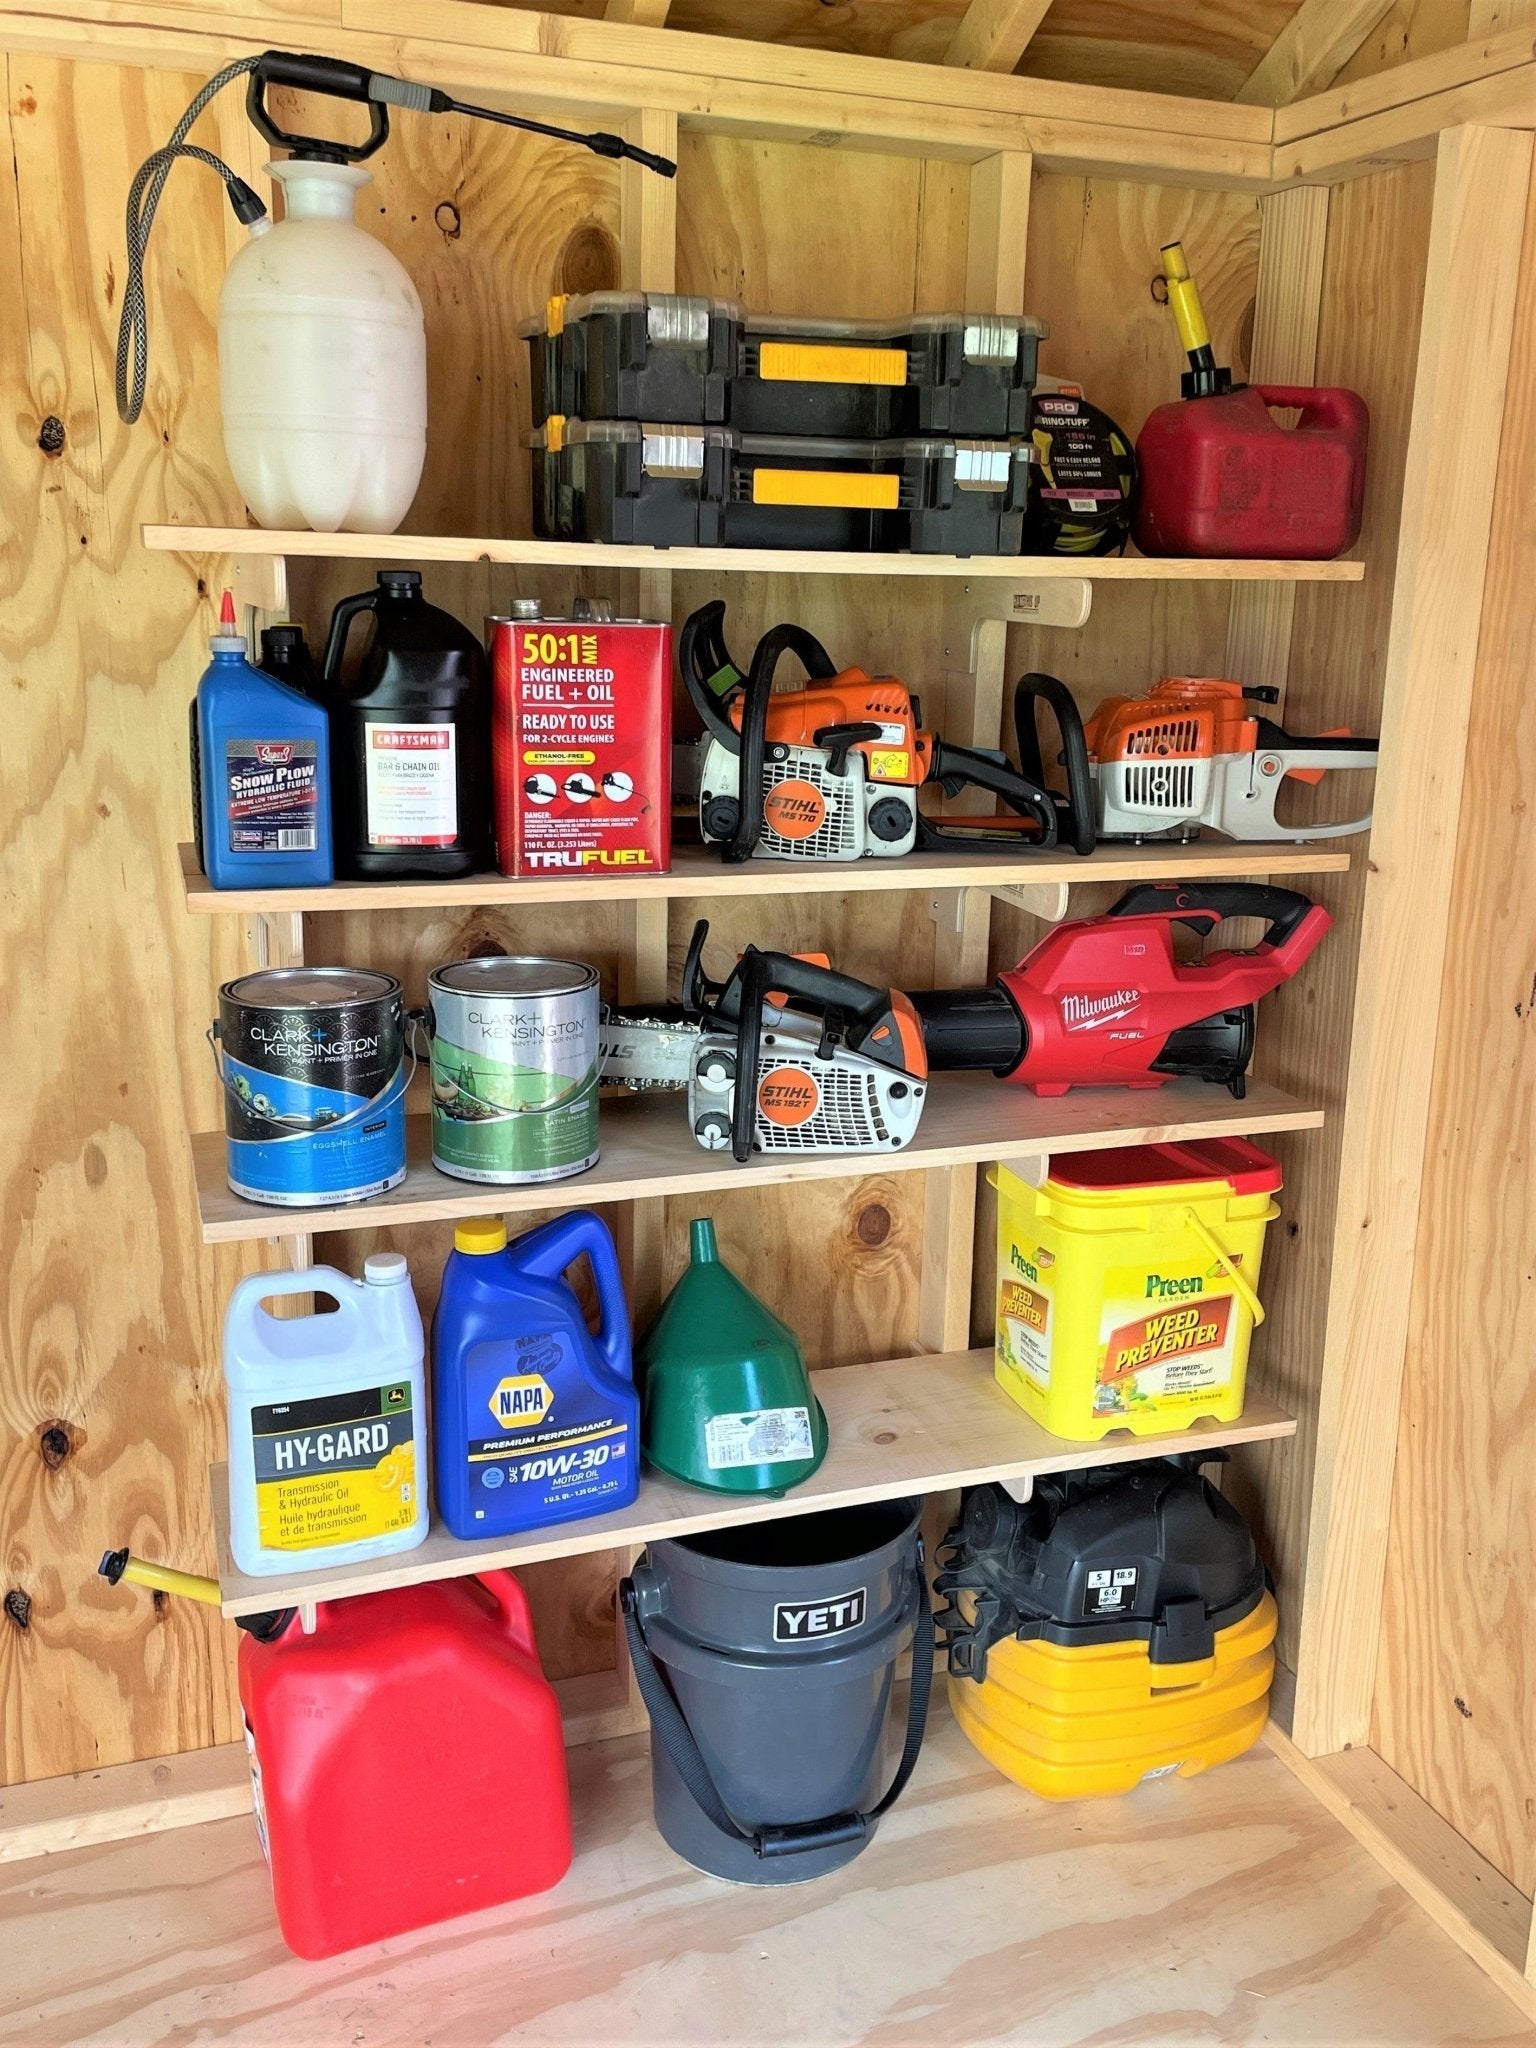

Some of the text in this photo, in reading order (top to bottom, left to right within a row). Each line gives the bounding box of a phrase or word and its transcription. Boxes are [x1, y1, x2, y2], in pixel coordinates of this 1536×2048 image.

[1044, 403, 1075, 412] PRO
[1042, 417, 1088, 426] RINO-TUFF
[522, 633, 598, 665] 50:1 MIX
[521, 668, 615, 682] ENGINEERED
[522, 684, 615, 701] FUEL + OIL
[522, 714, 615, 730] READY TO USE
[377, 734, 445, 746] CRAFTSMAN
[523, 734, 615, 743] FOR 2-CYCLE ENGINES
[378, 762, 393, 771] BAR
[402, 762, 427, 771] CHAIN
[428, 762, 440, 771] OIL
[230, 765, 315, 791] SNOW PLOW
[236, 783, 286, 799] HYDRAULIC
[287, 778, 311, 790] FLUID
[231, 799, 254, 808] EXTREME
[255, 797, 266, 805] LOW
[266, 789, 301, 801] TEMPERATURE
[768, 797, 820, 813] STIHL
[524, 811, 552, 819] DANGER:
[778, 811, 816, 822] MS 170
[524, 850, 653, 867] TRUFUEL
[1061, 990, 1141, 1024] Milwaukee
[250, 1027, 327, 1042] CLARK+
[481, 1020, 585, 1039] KENSINGTON
[1110, 1032, 1144, 1040] FUEL
[264, 1036, 379, 1057] KENSINGTON
[292, 1057, 316, 1065] PAINT
[324, 1053, 355, 1064] PRIMER
[355, 1053, 363, 1061] IN
[363, 1050, 379, 1059] ONE
[762, 1086, 812, 1098] STIHL
[764, 1099, 782, 1107] MS
[544, 1118, 566, 1126] SATIN
[312, 1131, 387, 1149] EGGSHELL ENAMEL
[1010, 1244, 1037, 1282] Preen
[1145, 1274, 1203, 1298] Preen
[1012, 1285, 1033, 1308] WEED
[1158, 1295, 1190, 1303] GARDEN
[1002, 1297, 1042, 1328] PREVENTER
[1145, 1309, 1201, 1342] WEED
[1116, 1324, 1219, 1373] PREVENTER
[499, 1387, 544, 1416] NAPA
[483, 1418, 613, 1450] PREMIUM PERFORMANCE
[274, 1423, 390, 1471] HY-GARD
[509, 1445, 610, 1483] SAE 10W-30
[552, 1472, 584, 1486] MOTOR
[585, 1469, 599, 1479] OIL
[278, 1479, 339, 1498] Transmission
[279, 1488, 349, 1510] & Hydraulic Oil
[280, 1502, 361, 1525] Huile hydraulique
[280, 1513, 367, 1537] et de transmission
[1097, 1571, 1133, 1581] 5 18.9
[1104, 1589, 1117, 1597] 6.0
[781, 1598, 859, 1635] YETI
